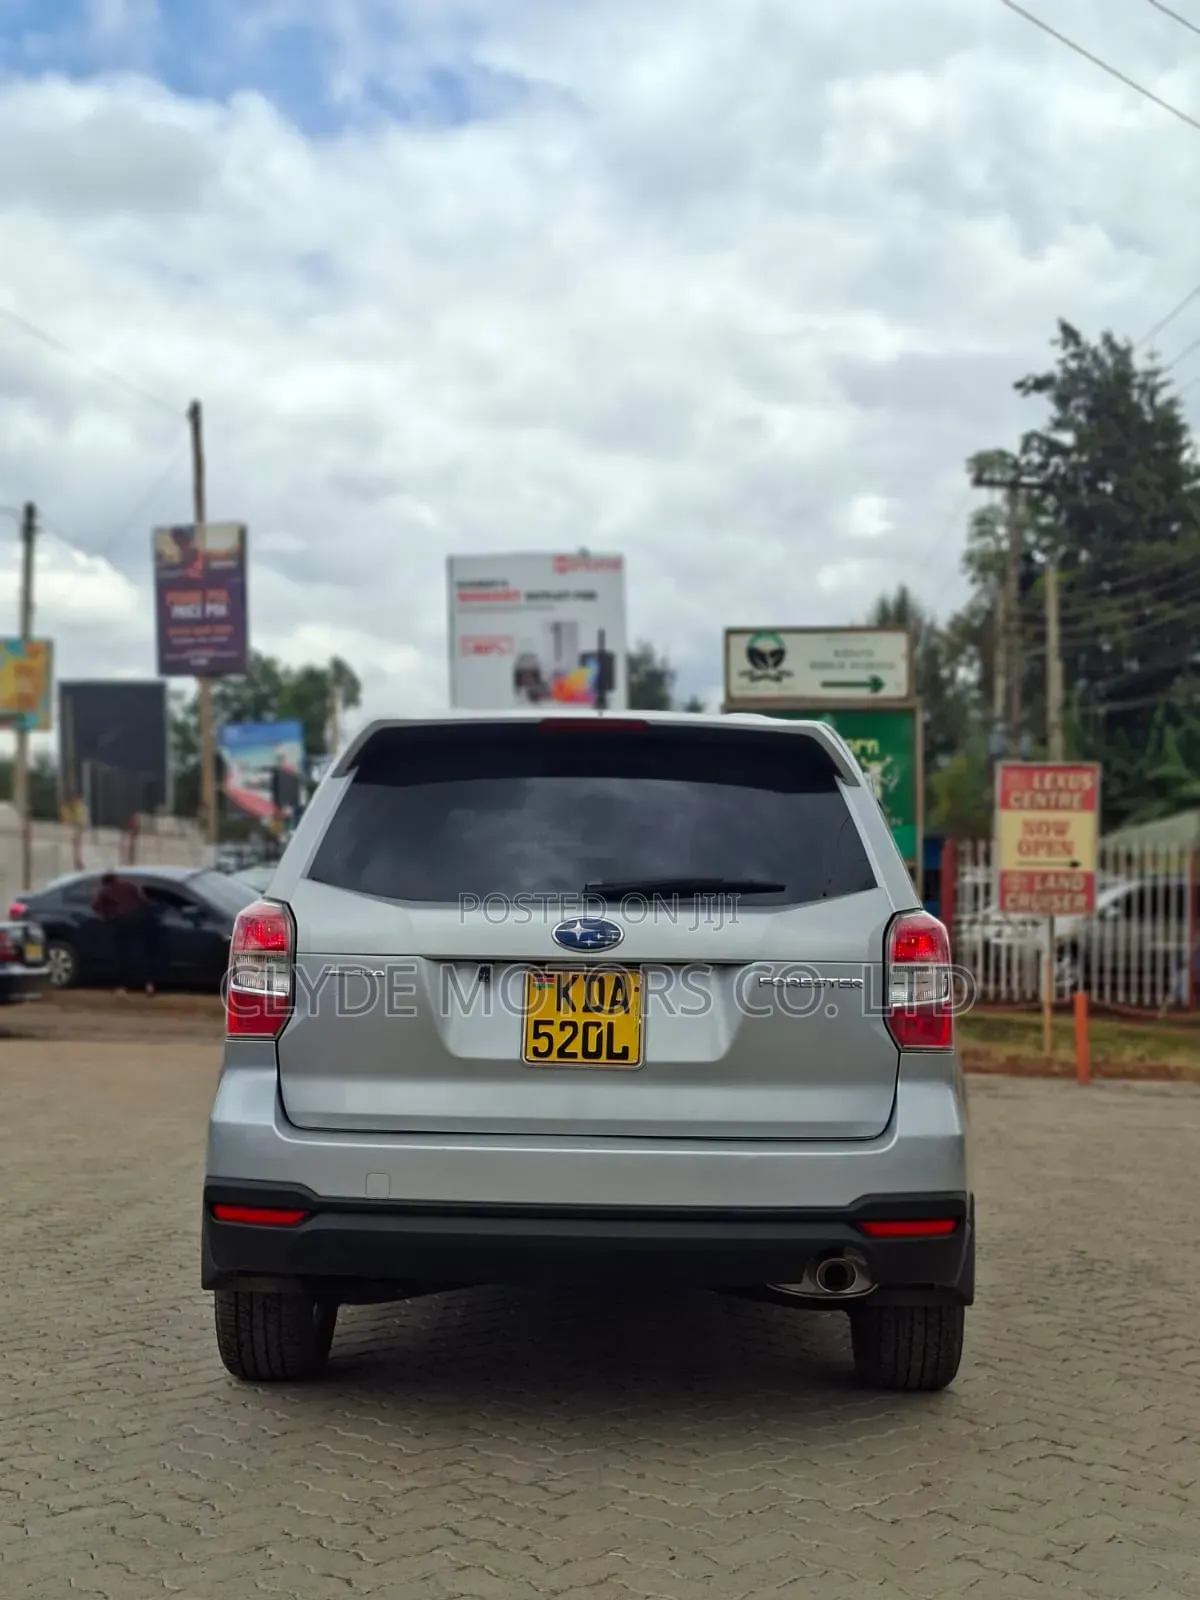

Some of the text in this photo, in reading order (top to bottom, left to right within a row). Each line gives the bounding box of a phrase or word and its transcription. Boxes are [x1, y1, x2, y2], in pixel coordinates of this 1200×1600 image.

[1033, 772, 1093, 790] LEXUS
[1009, 791, 1083, 809] CENTRE
[1022, 819, 1070, 836] NOW
[1017, 840, 1074, 857] OPEN
[1033, 873, 1085, 891] LAND
[1005, 892, 1087, 911] CRUISER
[759, 977, 864, 989] FORESTER
[532, 1019, 629, 1060] 520L
